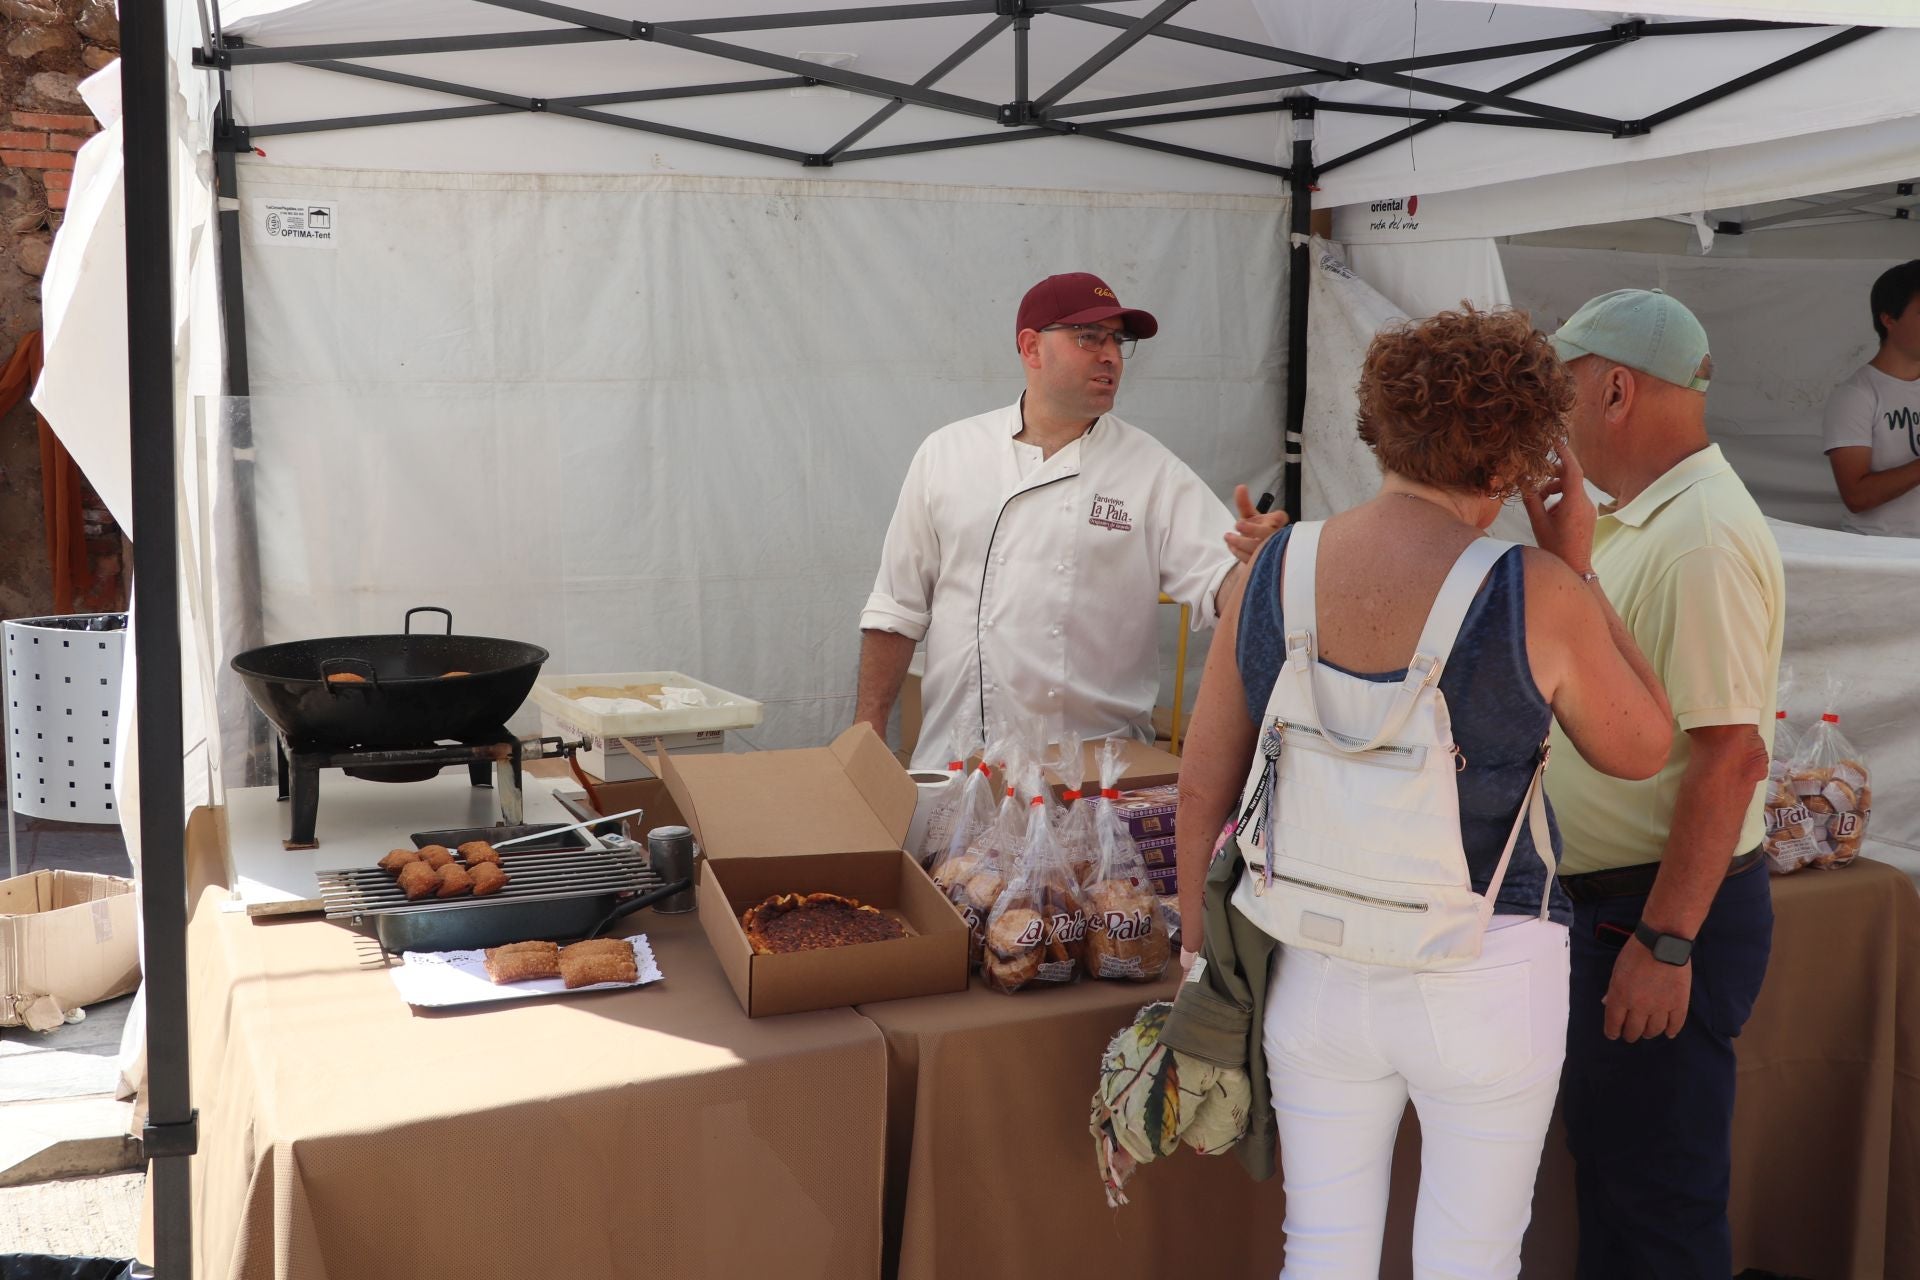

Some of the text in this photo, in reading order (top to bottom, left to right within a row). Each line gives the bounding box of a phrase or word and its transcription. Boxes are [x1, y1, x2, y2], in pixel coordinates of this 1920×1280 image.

[1371, 199, 1403, 212] oriental
[1370, 213, 1419, 230] ruta del vino
[281, 229, 331, 238] OPTIMA-Tent
[1884, 406, 1920, 457] Mo
[1090, 501, 1128, 522] La Pala
[1837, 812, 1857, 836] La
[1016, 919, 1043, 945] La
[1046, 911, 1088, 945] Pala
[1105, 910, 1151, 940] Pala
